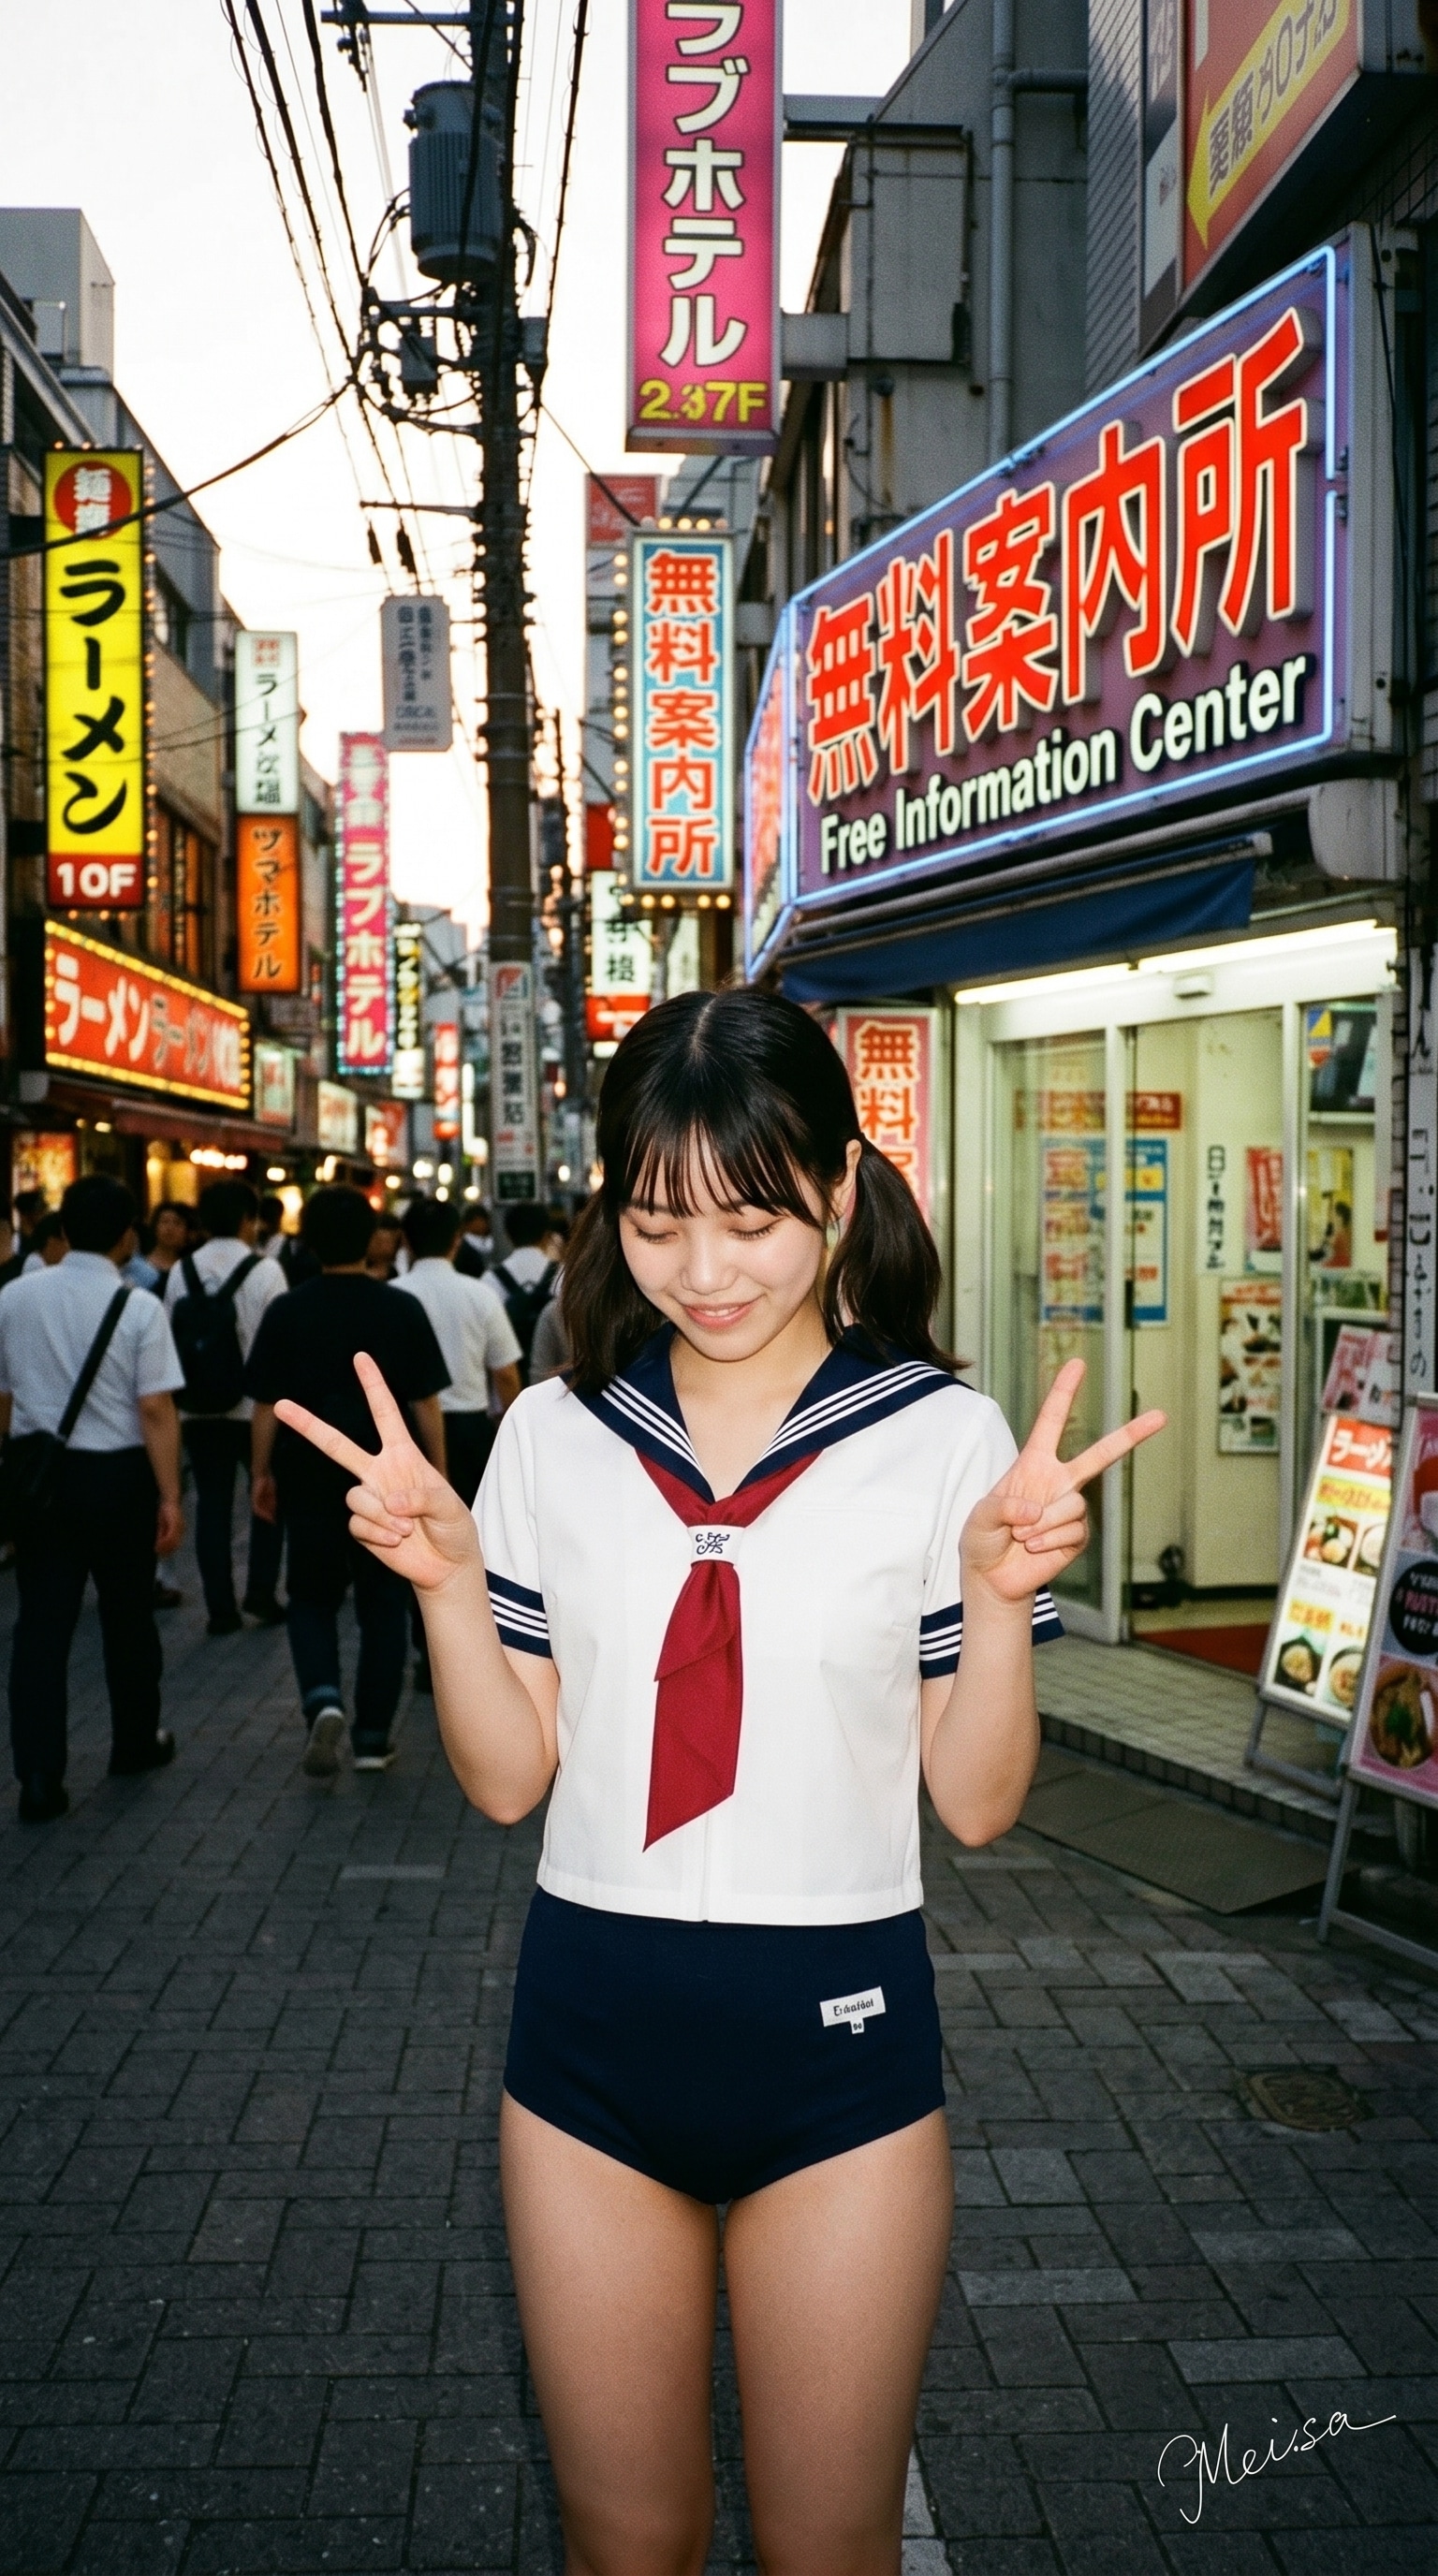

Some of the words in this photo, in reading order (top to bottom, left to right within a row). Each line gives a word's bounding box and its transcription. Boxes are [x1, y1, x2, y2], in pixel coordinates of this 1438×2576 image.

[660, 0, 750, 367] ラブホテル
[808, 308, 1307, 806] 無料案内所
[59, 559, 128, 835] ラーメン
[647, 551, 717, 880] 無料案内所
[820, 813, 888, 876] Free
[895, 727, 1119, 851] Information
[1130, 655, 1309, 773] Center
[57, 863, 136, 899] 10F
[858, 1024, 917, 1187] 無料
